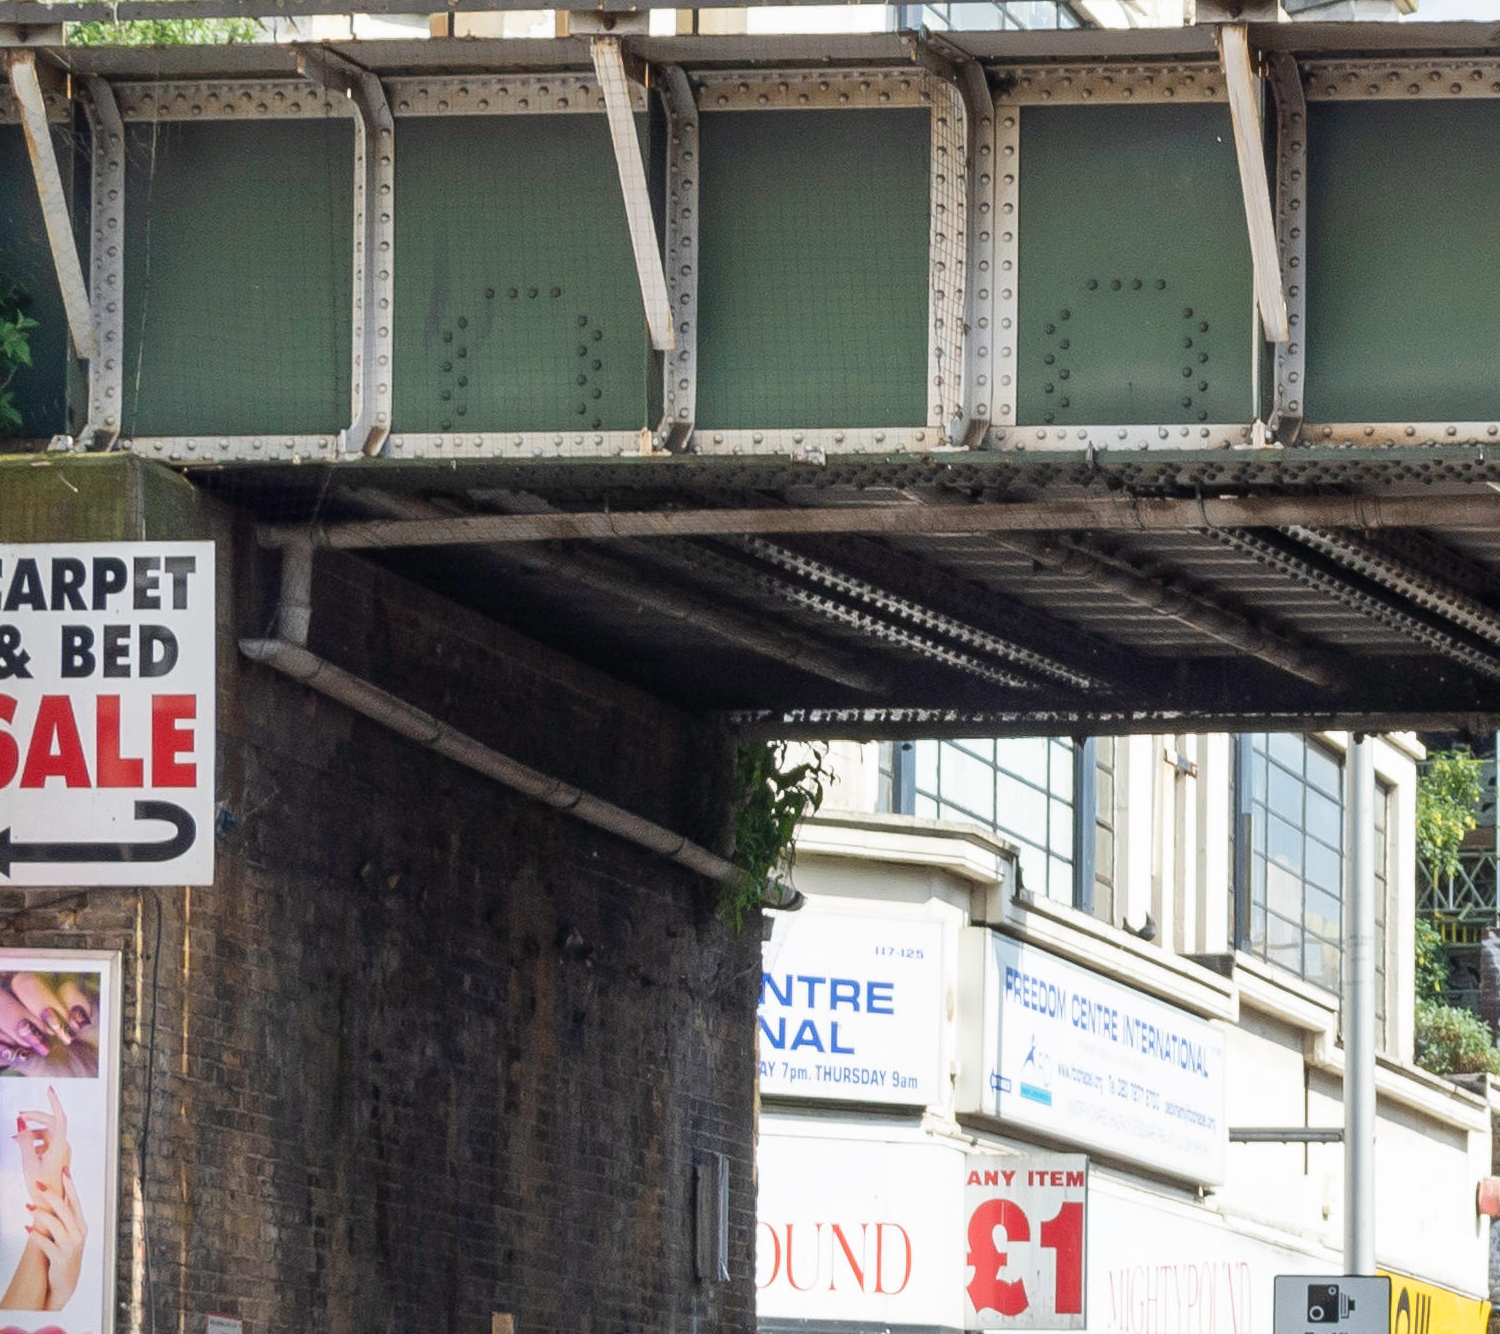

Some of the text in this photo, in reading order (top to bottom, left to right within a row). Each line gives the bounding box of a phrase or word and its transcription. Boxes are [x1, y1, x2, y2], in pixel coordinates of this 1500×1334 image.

[60, 624, 179, 678] BED
[1006, 966, 1209, 1078] FREEDOM CENTRE INTERNATIONAL
[815, 1064, 887, 1087] THURSDAY
[893, 1070, 918, 1089] 9am
[966, 1170, 1085, 1188] ANY ITEM
[966, 1198, 1085, 1317] £1
